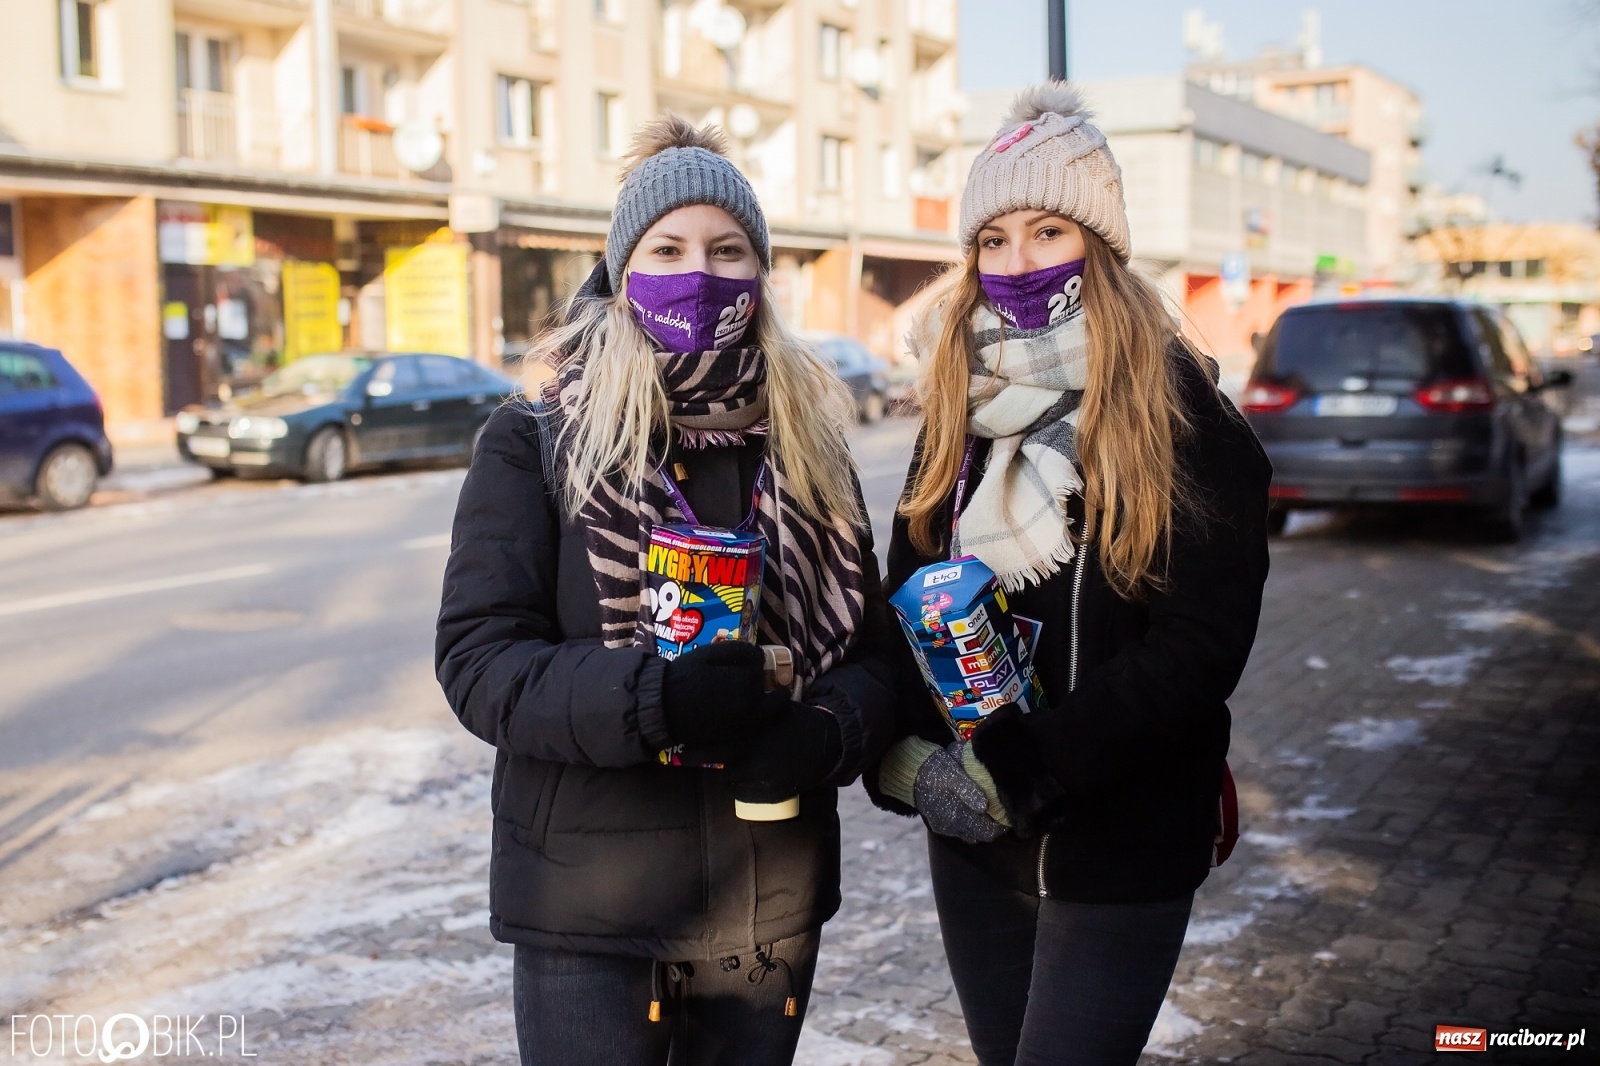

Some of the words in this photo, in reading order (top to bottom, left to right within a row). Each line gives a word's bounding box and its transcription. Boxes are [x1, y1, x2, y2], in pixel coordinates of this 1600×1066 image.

[714, 292, 750, 338] 29
[967, 609, 985, 629] onet
[968, 645, 1002, 669] mBank
[974, 664, 1009, 689] PLAY
[981, 682, 1019, 710] allegro
